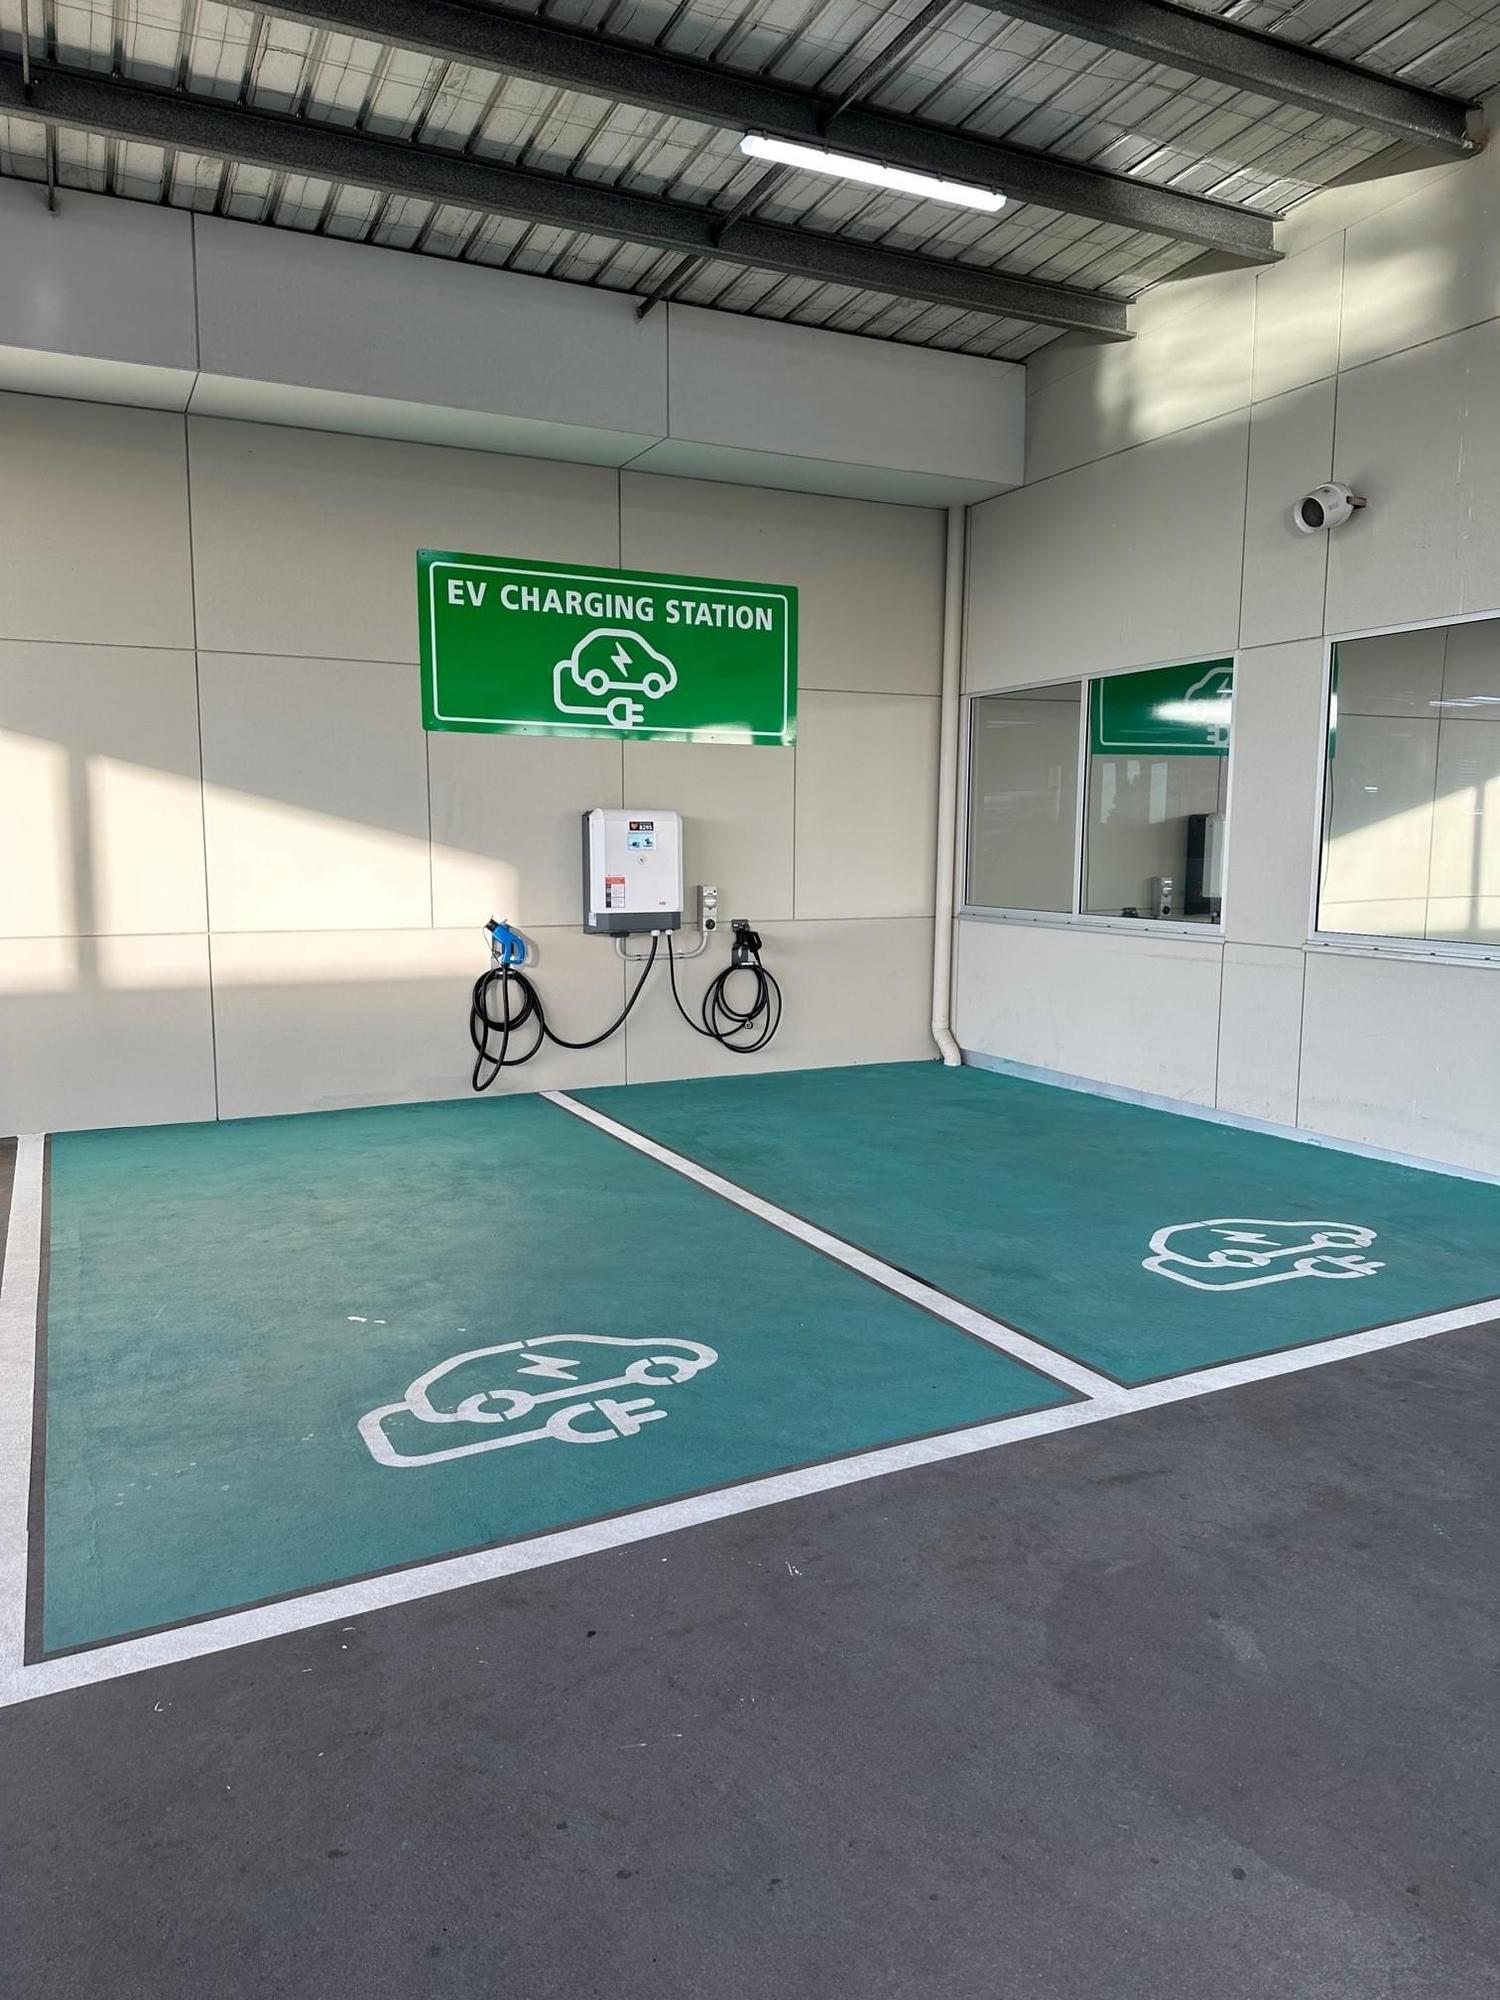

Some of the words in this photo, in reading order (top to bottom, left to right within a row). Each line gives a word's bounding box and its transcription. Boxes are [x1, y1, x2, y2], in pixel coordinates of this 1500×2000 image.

[448, 580, 487, 607] EV
[500, 584, 654, 622] CHARGING
[665, 599, 773, 631] STATION
